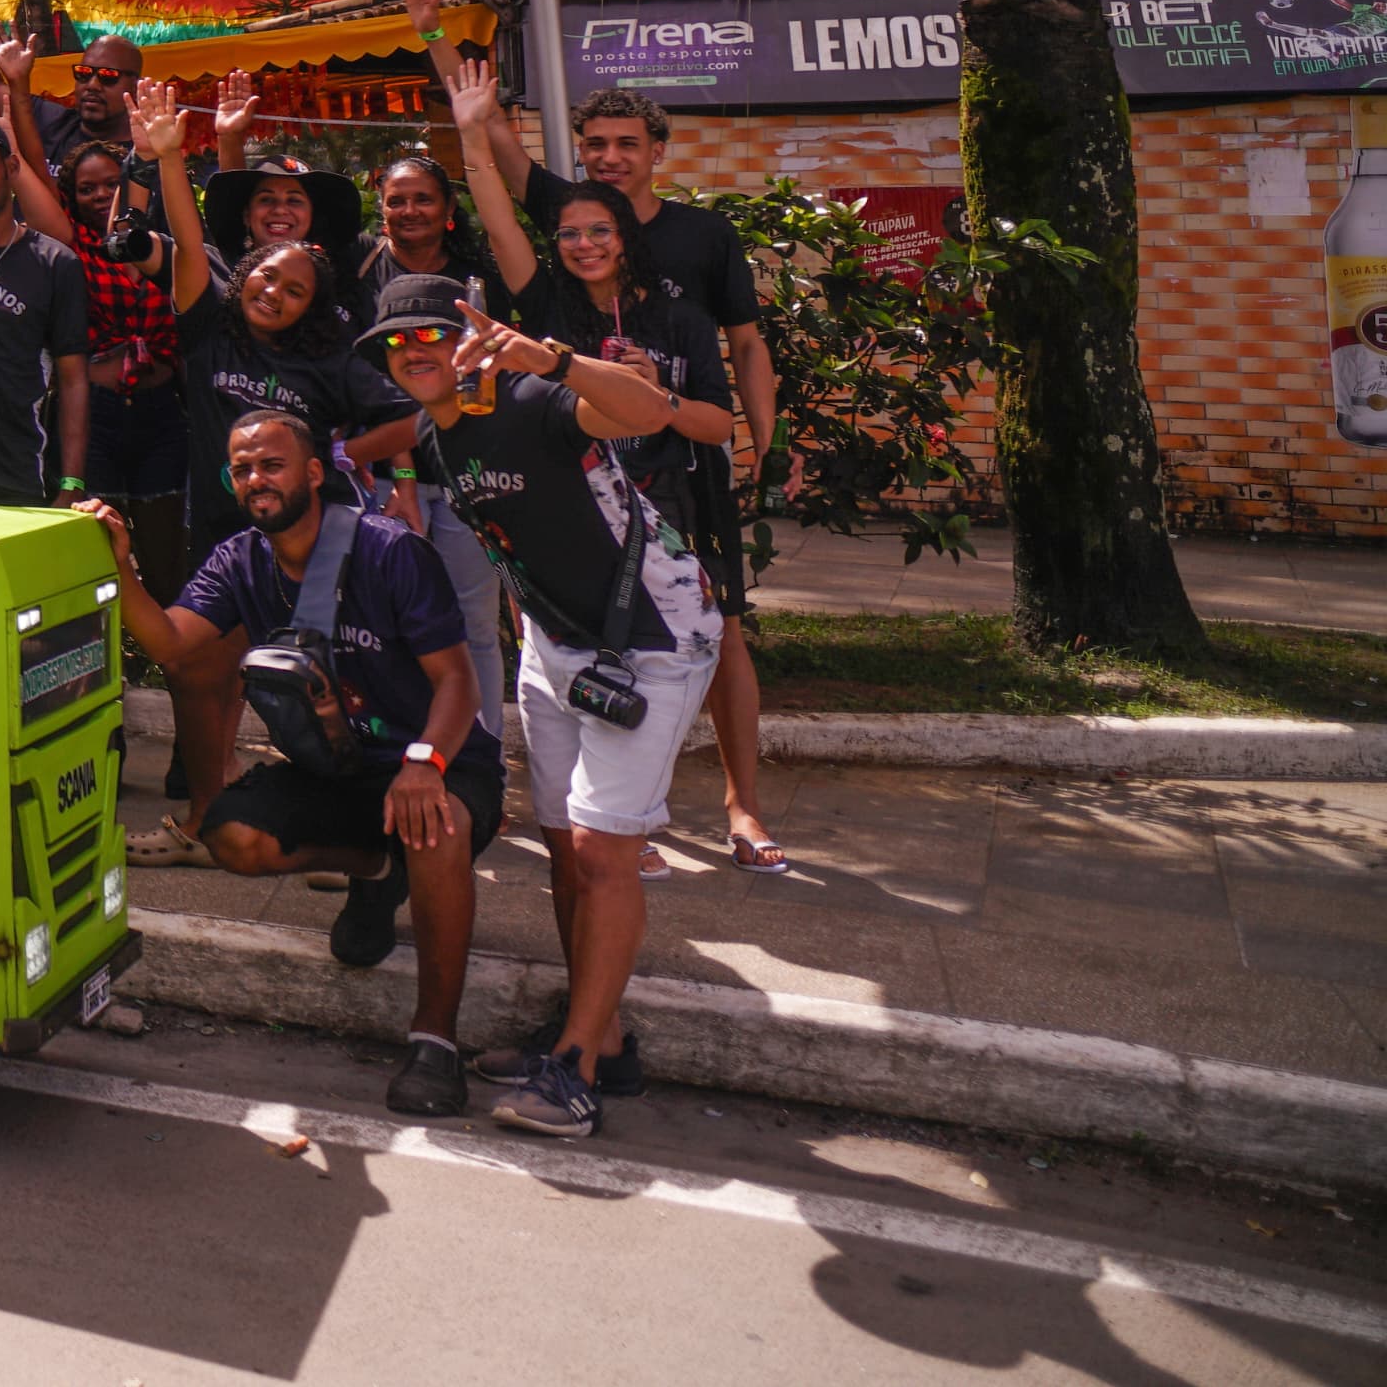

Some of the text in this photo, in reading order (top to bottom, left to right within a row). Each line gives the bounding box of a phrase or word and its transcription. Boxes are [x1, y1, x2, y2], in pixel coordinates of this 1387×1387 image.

[1116, 21, 1245, 47] QUE VOCÊ
[582, 47, 754, 62] aposta esportiva
[1166, 48, 1251, 67] CONFIA
[595, 60, 739, 74] arenaesportiva.com
[1273, 60, 1298, 76] EM
[868, 214, 916, 235] ITAIPAVA
[58, 758, 97, 814] SCANIA
